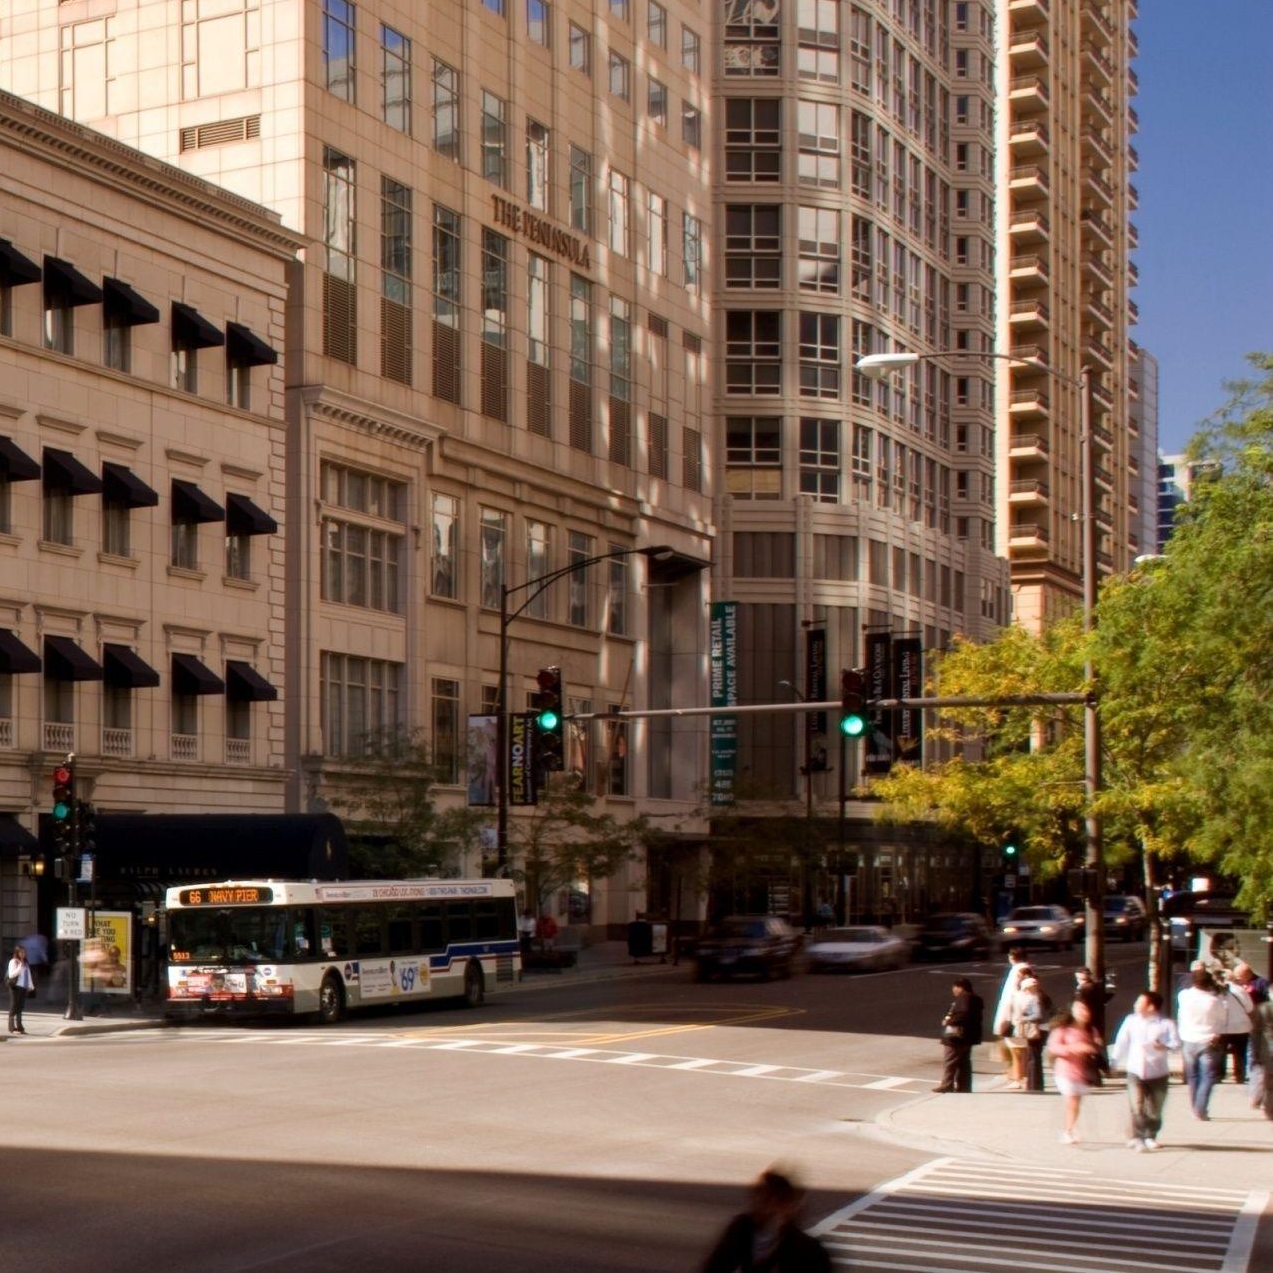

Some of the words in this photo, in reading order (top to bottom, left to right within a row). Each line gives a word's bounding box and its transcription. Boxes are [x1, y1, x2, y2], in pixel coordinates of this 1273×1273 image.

[491, 193, 521, 232] THE
[523, 211, 590, 272] PENINSULA
[711, 618, 723, 657] RETAIL
[725, 605, 736, 666] AVAILABLE
[711, 660, 723, 698] PRIME
[189, 891, 202, 904] 66
[209, 890, 234, 903] NAVY
[235, 889, 259, 902] PIER
